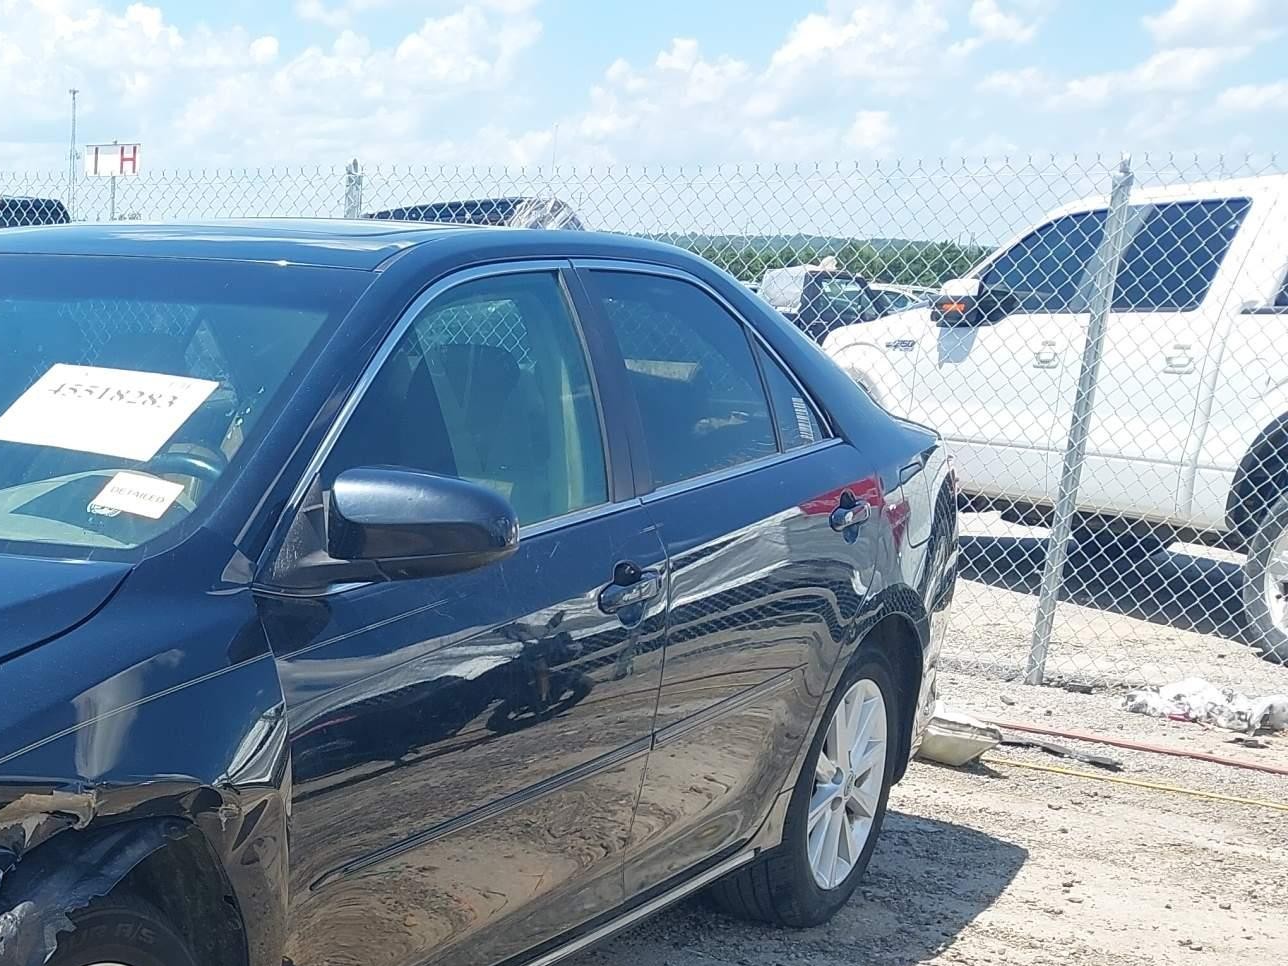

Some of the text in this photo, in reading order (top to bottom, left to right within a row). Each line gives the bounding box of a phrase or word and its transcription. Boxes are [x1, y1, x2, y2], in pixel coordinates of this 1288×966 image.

[119, 145, 137, 175] H
[47, 382, 180, 409] 45518283
[109, 486, 166, 503] DETAILED
